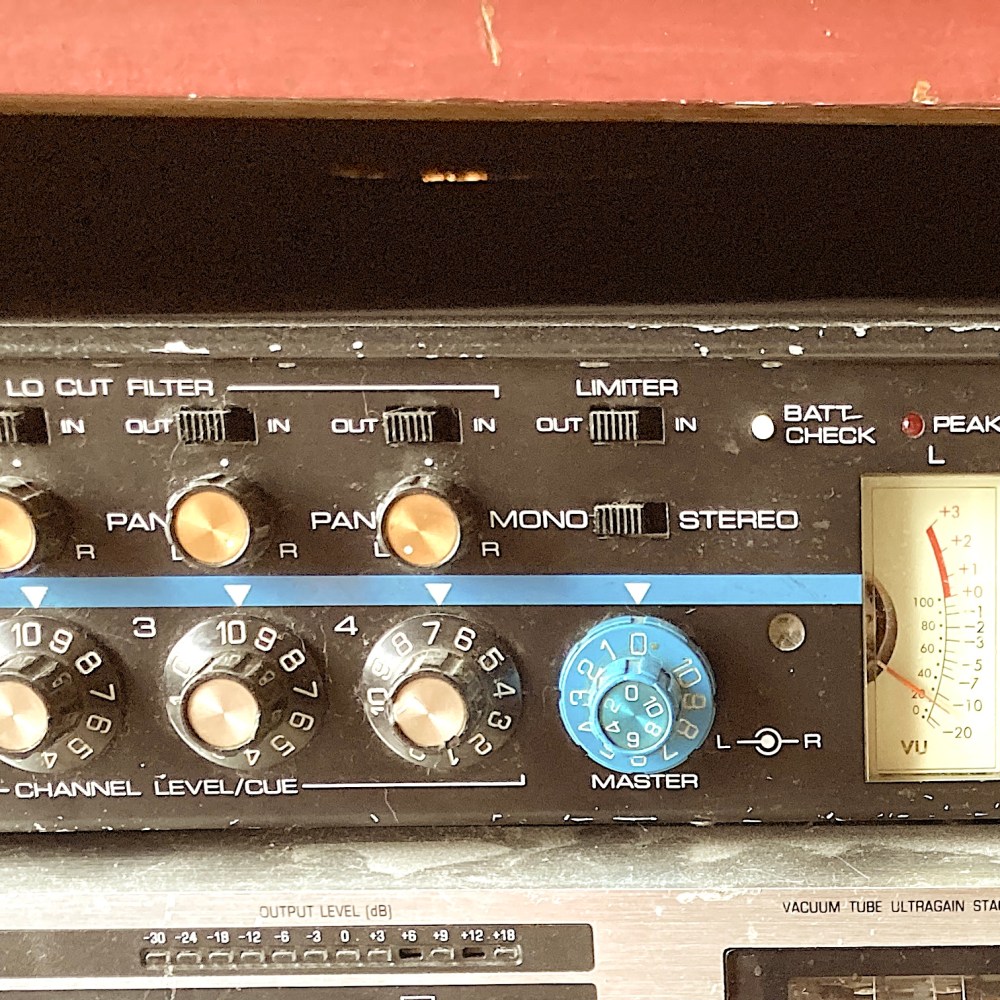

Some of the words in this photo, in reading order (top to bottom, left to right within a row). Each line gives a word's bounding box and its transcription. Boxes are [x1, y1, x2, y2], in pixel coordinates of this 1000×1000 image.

[6, 379, 44, 398] LO
[56, 379, 113, 398] CUT
[127, 379, 214, 398] FILTER
[575, 379, 678, 397] LIMITER
[60, 419, 85, 434] IN
[125, 418, 173, 434] OUT
[267, 418, 291, 433] IN
[330, 417, 378, 433] OUT
[473, 417, 496, 432] IN
[535, 417, 583, 433] OUT
[675, 417, 698, 432] IN
[786, 427, 876, 444] CHECK
[928, 445, 945, 465] L
[678, 510, 799, 530] STEREO
[939, 506, 960, 518] +3
[310, 511, 377, 530] PAN
[489, 511, 589, 530] MONO
[75, 544, 96, 560] R
[280, 542, 298, 558] R
[481, 542, 500, 557] R
[132, 616, 157, 638] 3
[215, 620, 247, 645] 10
[334, 615, 359, 636] 4
[421, 621, 442, 645] 7
[630, 632, 647, 655] 0
[716, 735, 732, 749] L
[803, 734, 822, 748] R
[901, 741, 928, 755] VU
[14, 781, 141, 798] CHANNEL
[154, 778, 299, 796] LEVEL/CUE
[591, 774, 699, 790] MASTER
[260, 906, 314, 918] OUTPUT
[320, 905, 360, 918] LEVEL
[366, 905, 392, 920] (dB)
[782, 901, 841, 913] VACUUM
[850, 901, 882, 913] TUBE
[891, 900, 965, 912] ULTRAGAIN
[142, 931, 166, 944] -30
[174, 931, 198, 944] -24
[206, 930, 230, 943] -18
[401, 929, 417, 941] +6
[461, 928, 484, 941] +12
[493, 928, 516, 941] +18
